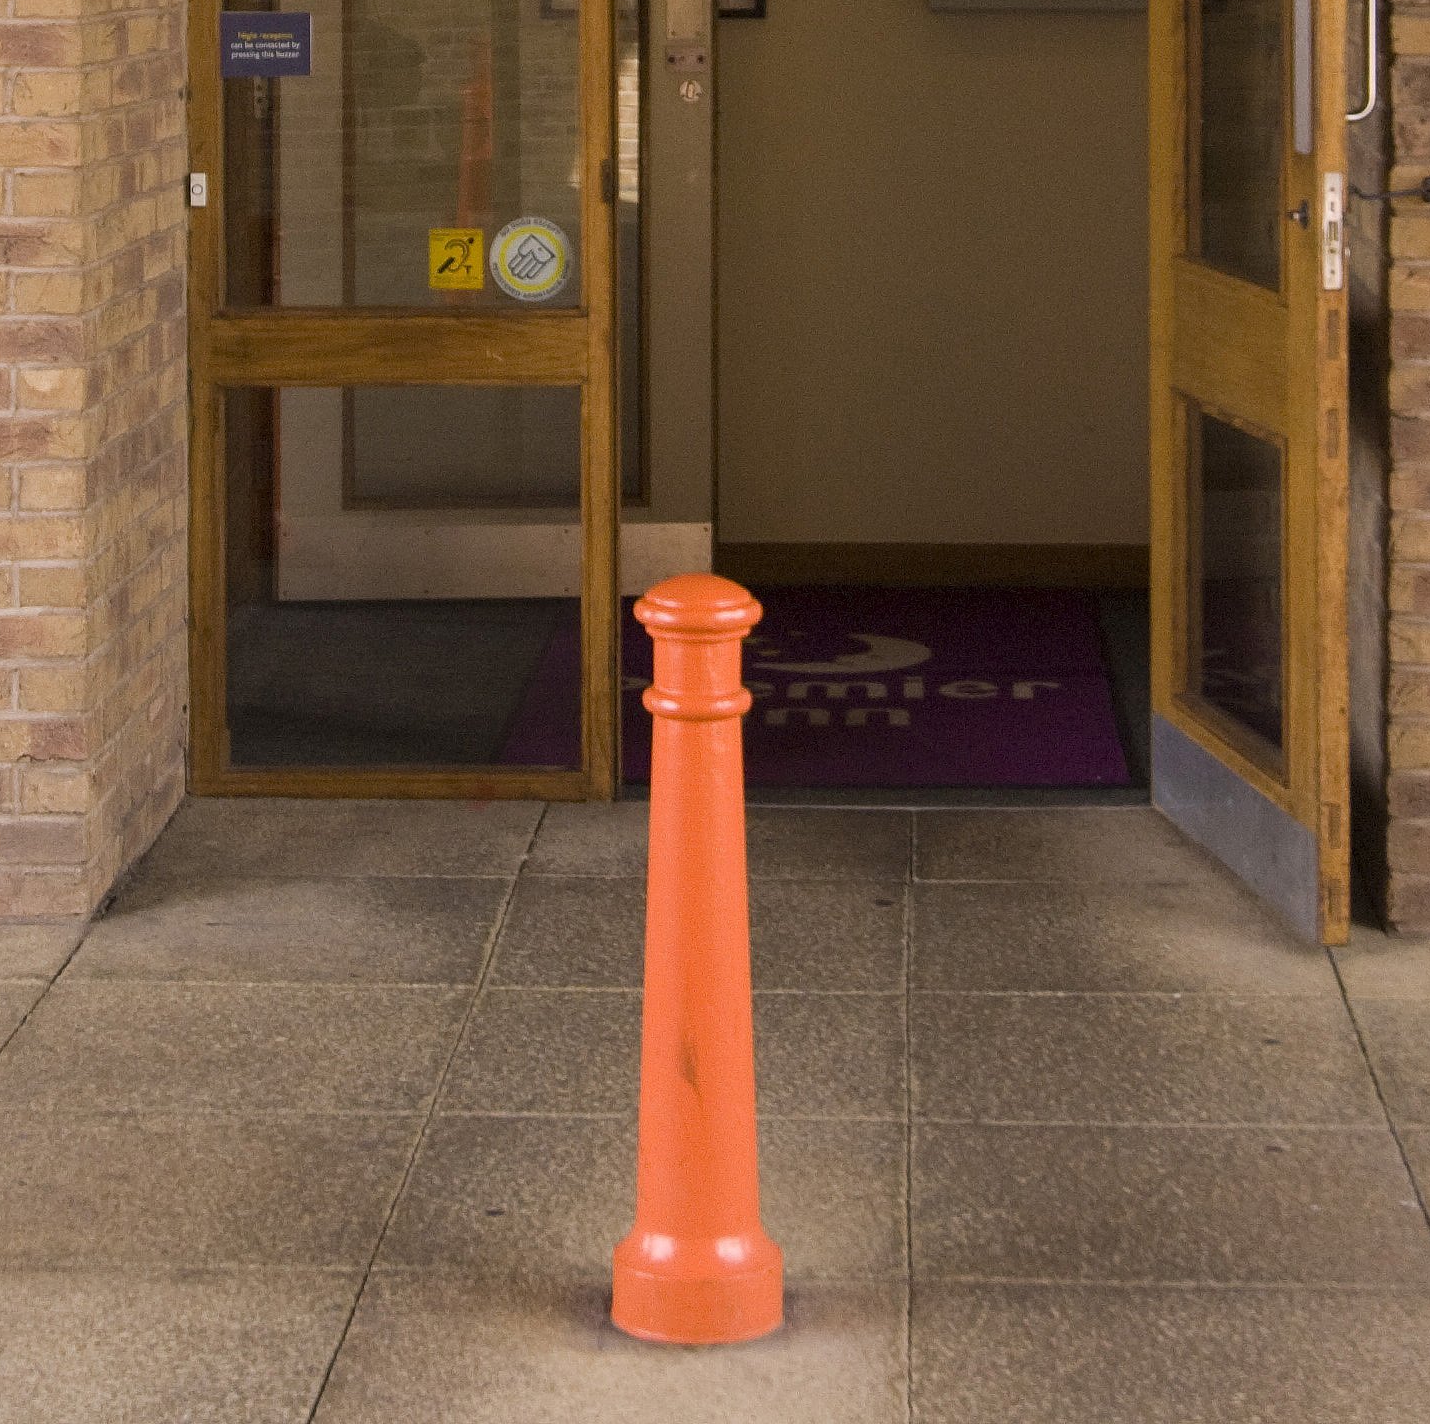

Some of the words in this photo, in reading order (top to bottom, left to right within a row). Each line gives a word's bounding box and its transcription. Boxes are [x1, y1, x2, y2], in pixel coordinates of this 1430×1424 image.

[244, 40, 254, 49] be
[255, 41, 290, 49] contacted
[292, 41, 301, 50] by
[231, 51, 260, 60] pressing
[261, 50, 274, 58] this
